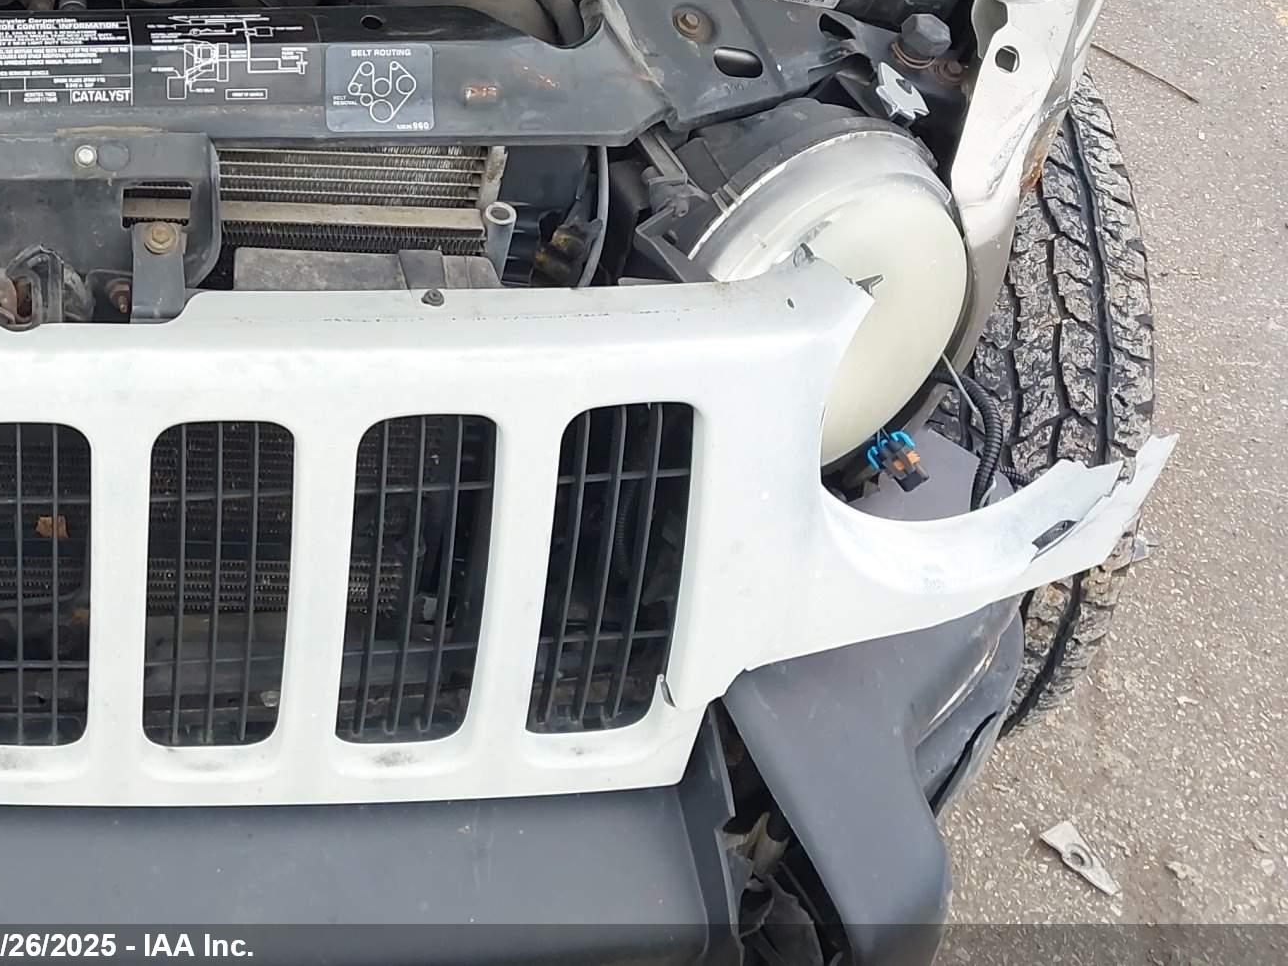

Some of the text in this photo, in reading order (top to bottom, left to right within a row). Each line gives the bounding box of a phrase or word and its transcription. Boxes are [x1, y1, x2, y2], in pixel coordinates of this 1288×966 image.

[16, 22, 59, 30] CONTROL
[60, 21, 119, 29] INFORMATION
[351, 48, 411, 57] BELT ROUTING
[72, 89, 130, 102] CATALYST
